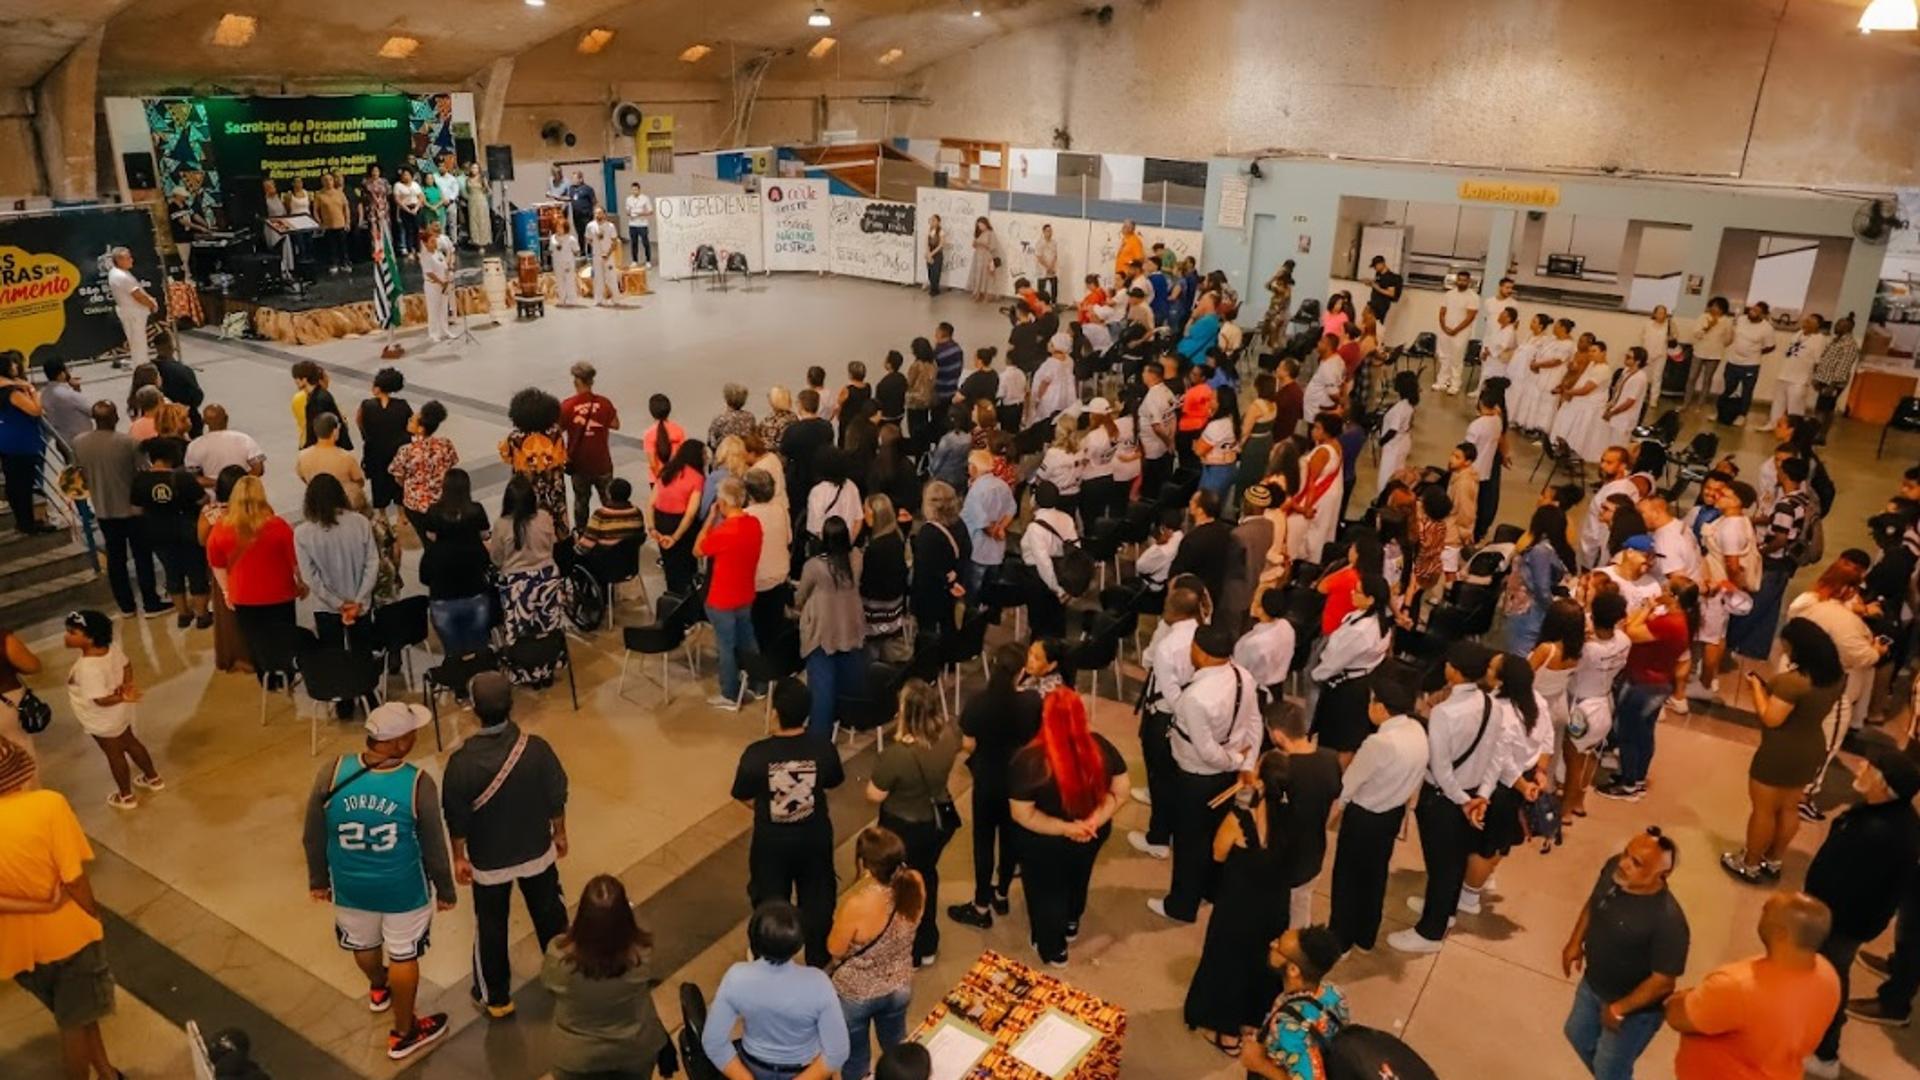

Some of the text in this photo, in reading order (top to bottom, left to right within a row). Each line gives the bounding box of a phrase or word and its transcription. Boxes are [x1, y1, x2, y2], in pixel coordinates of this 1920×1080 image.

[225, 117, 398, 134] Secretaria de Desenvolvimento
[266, 131, 366, 146] Social e Cidadania
[261, 157, 326, 171] Departamento
[769, 187, 782, 202] A
[659, 194, 760, 219] O INGREDIENTE
[0, 254, 15, 269] S
[0, 265, 43, 286] RAS
[343, 794, 398, 816] JORDAN
[338, 822, 398, 852] 23
